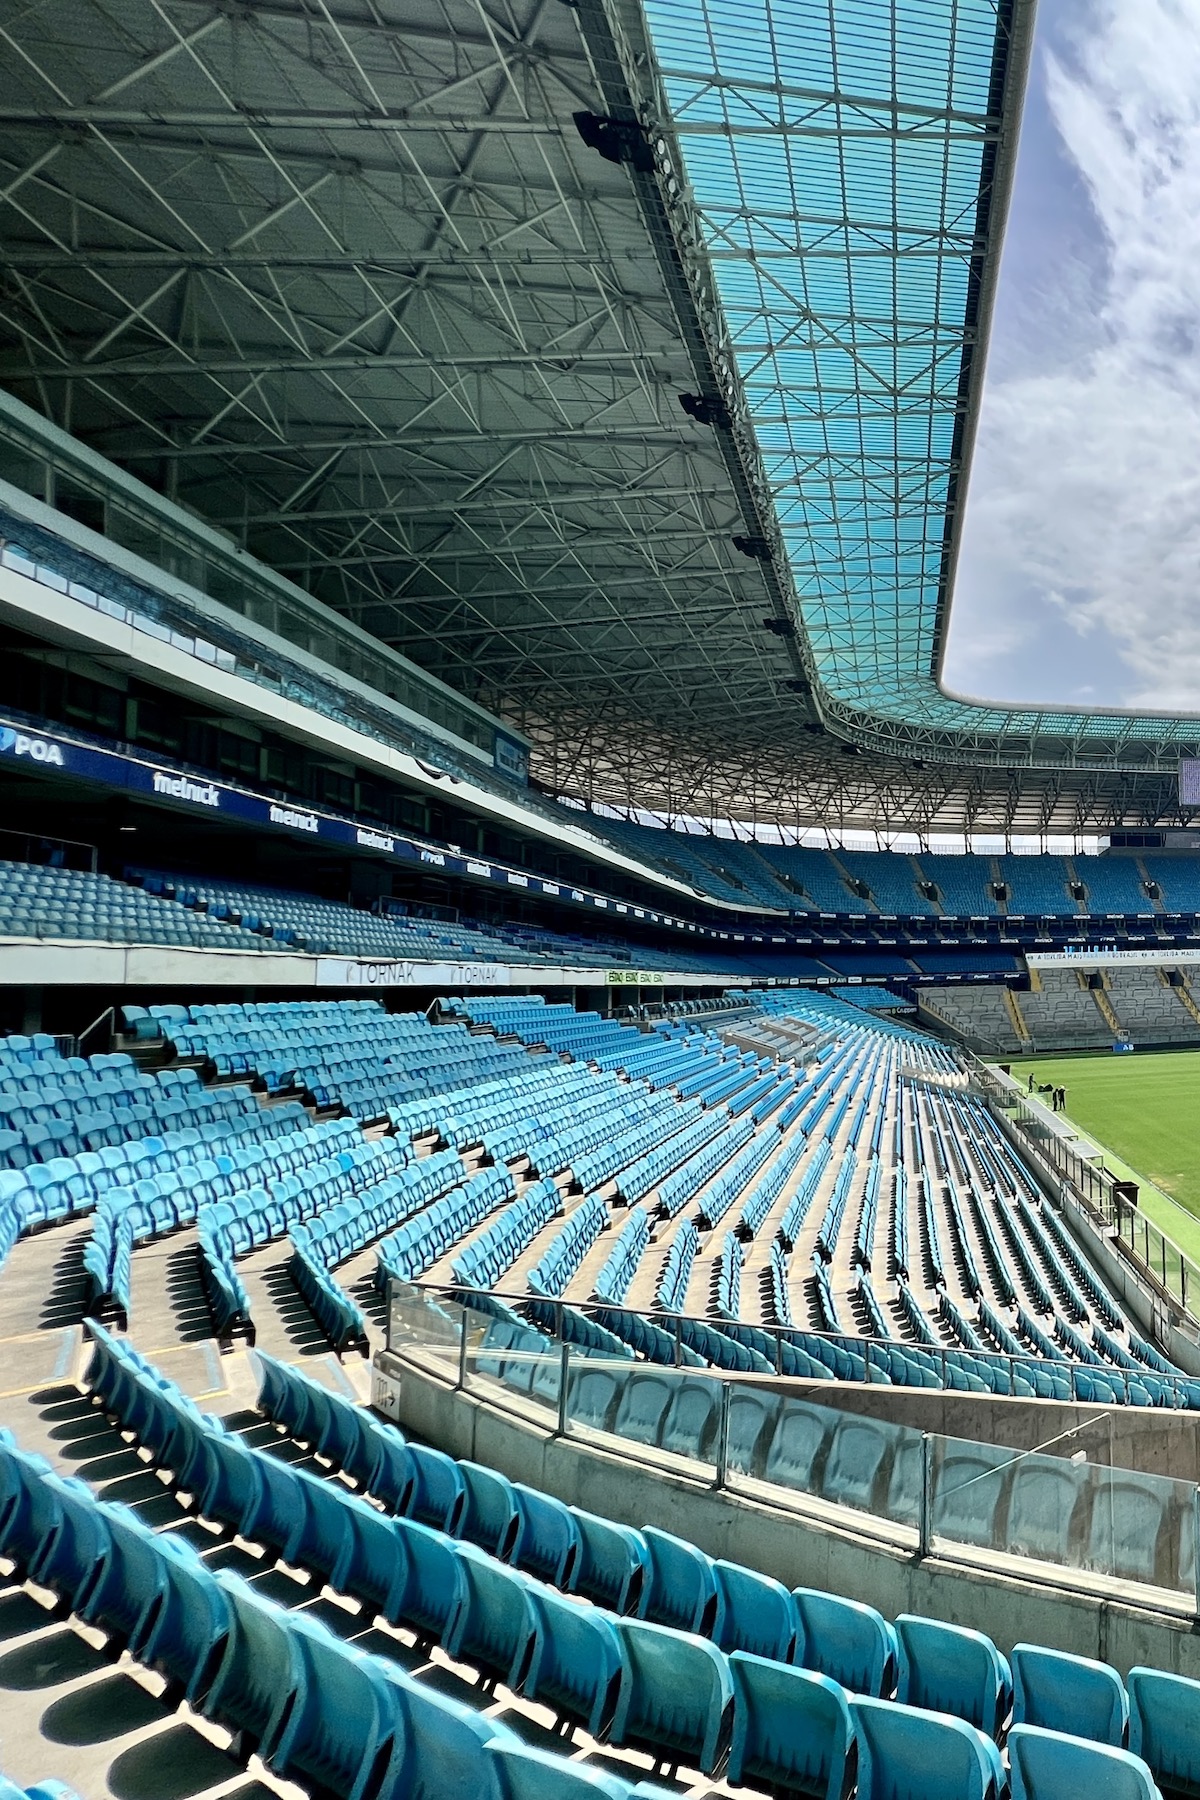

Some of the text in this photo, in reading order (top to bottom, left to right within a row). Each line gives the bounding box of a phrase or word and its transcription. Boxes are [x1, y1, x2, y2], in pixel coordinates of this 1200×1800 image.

[14, 734, 65, 766] POA
[153, 771, 220, 807] melnick
[357, 962, 415, 984] TORNAK
[458, 966, 498, 984] TORNAK
